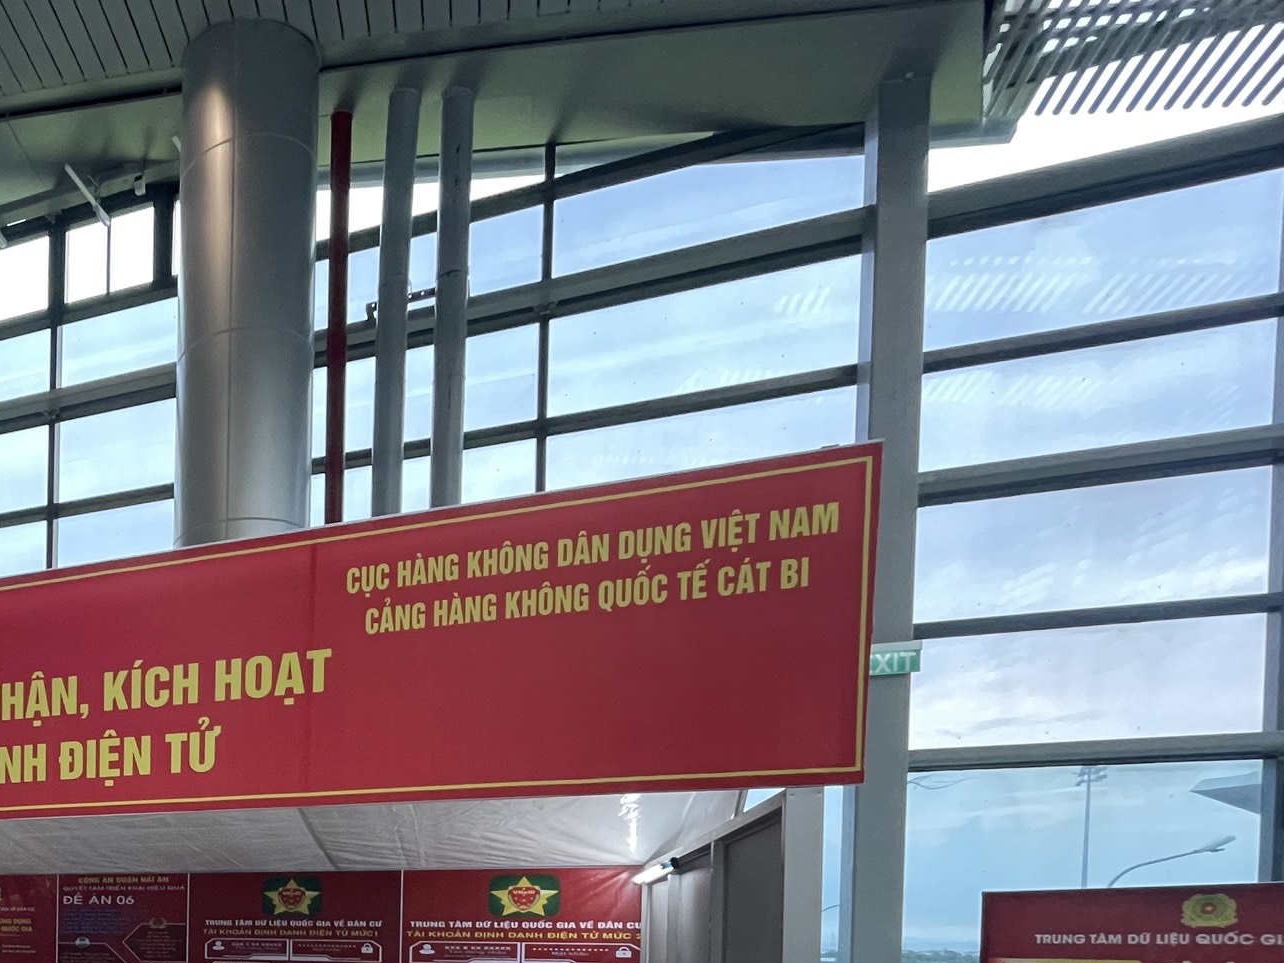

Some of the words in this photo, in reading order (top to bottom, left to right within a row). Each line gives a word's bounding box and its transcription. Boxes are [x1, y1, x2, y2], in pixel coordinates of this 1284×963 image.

[346, 563, 390, 598] CỤC
[397, 552, 459, 588] HÀNG
[467, 540, 549, 579] KHÔNG
[557, 530, 609, 568] DÂN
[618, 522, 692, 563] DỤNG
[700, 509, 761, 553] VIỆT
[768, 501, 839, 541] NAM
[365, 597, 426, 635] CẢNG
[433, 591, 497, 627] HÀNG
[505, 581, 589, 620] KHÔNG
[598, 565, 668, 612] QUỐC
[677, 558, 711, 600] TẾ
[717, 557, 772, 596] CÁT
[780, 556, 809, 590] BI
[869, 652, 916, 673] XIT
[103, 659, 199, 712] KÍCH
[214, 648, 332, 705] HOẠT
[58, 729, 152, 787] ĐIỆN
[165, 716, 222, 774] TỬ
[88, 892, 112, 905] ÁN
[116, 895, 135, 905] 06
[406, 930, 425, 938] TÀI
[428, 930, 471, 938] KHOẢN
[474, 931, 504, 941] ĐỊNH
[507, 931, 543, 939] DANH
[547, 930, 578, 940] ĐIỆN
[581, 930, 600, 940] TỬ
[602, 931, 632, 940] MỨC
[410, 920, 446, 929] TRUNG
[448, 920, 472, 929] TÂM
[475, 920, 492, 929] DỮ
[493, 920, 519, 931] LIỆU
[521, 919, 553, 929] QUỐC
[556, 921, 576, 929] GIA
[579, 920, 594, 929] VỀ
[597, 920, 623, 929] DÂN
[1034, 933, 1085, 944] TRUNG
[1089, 932, 1122, 944] TÂM
[1127, 932, 1151, 944] DỮ
[1156, 931, 1190, 947] LIỆU
[1196, 930, 1255, 945] QUỐC
[1259, 934, 1284, 945] GI
